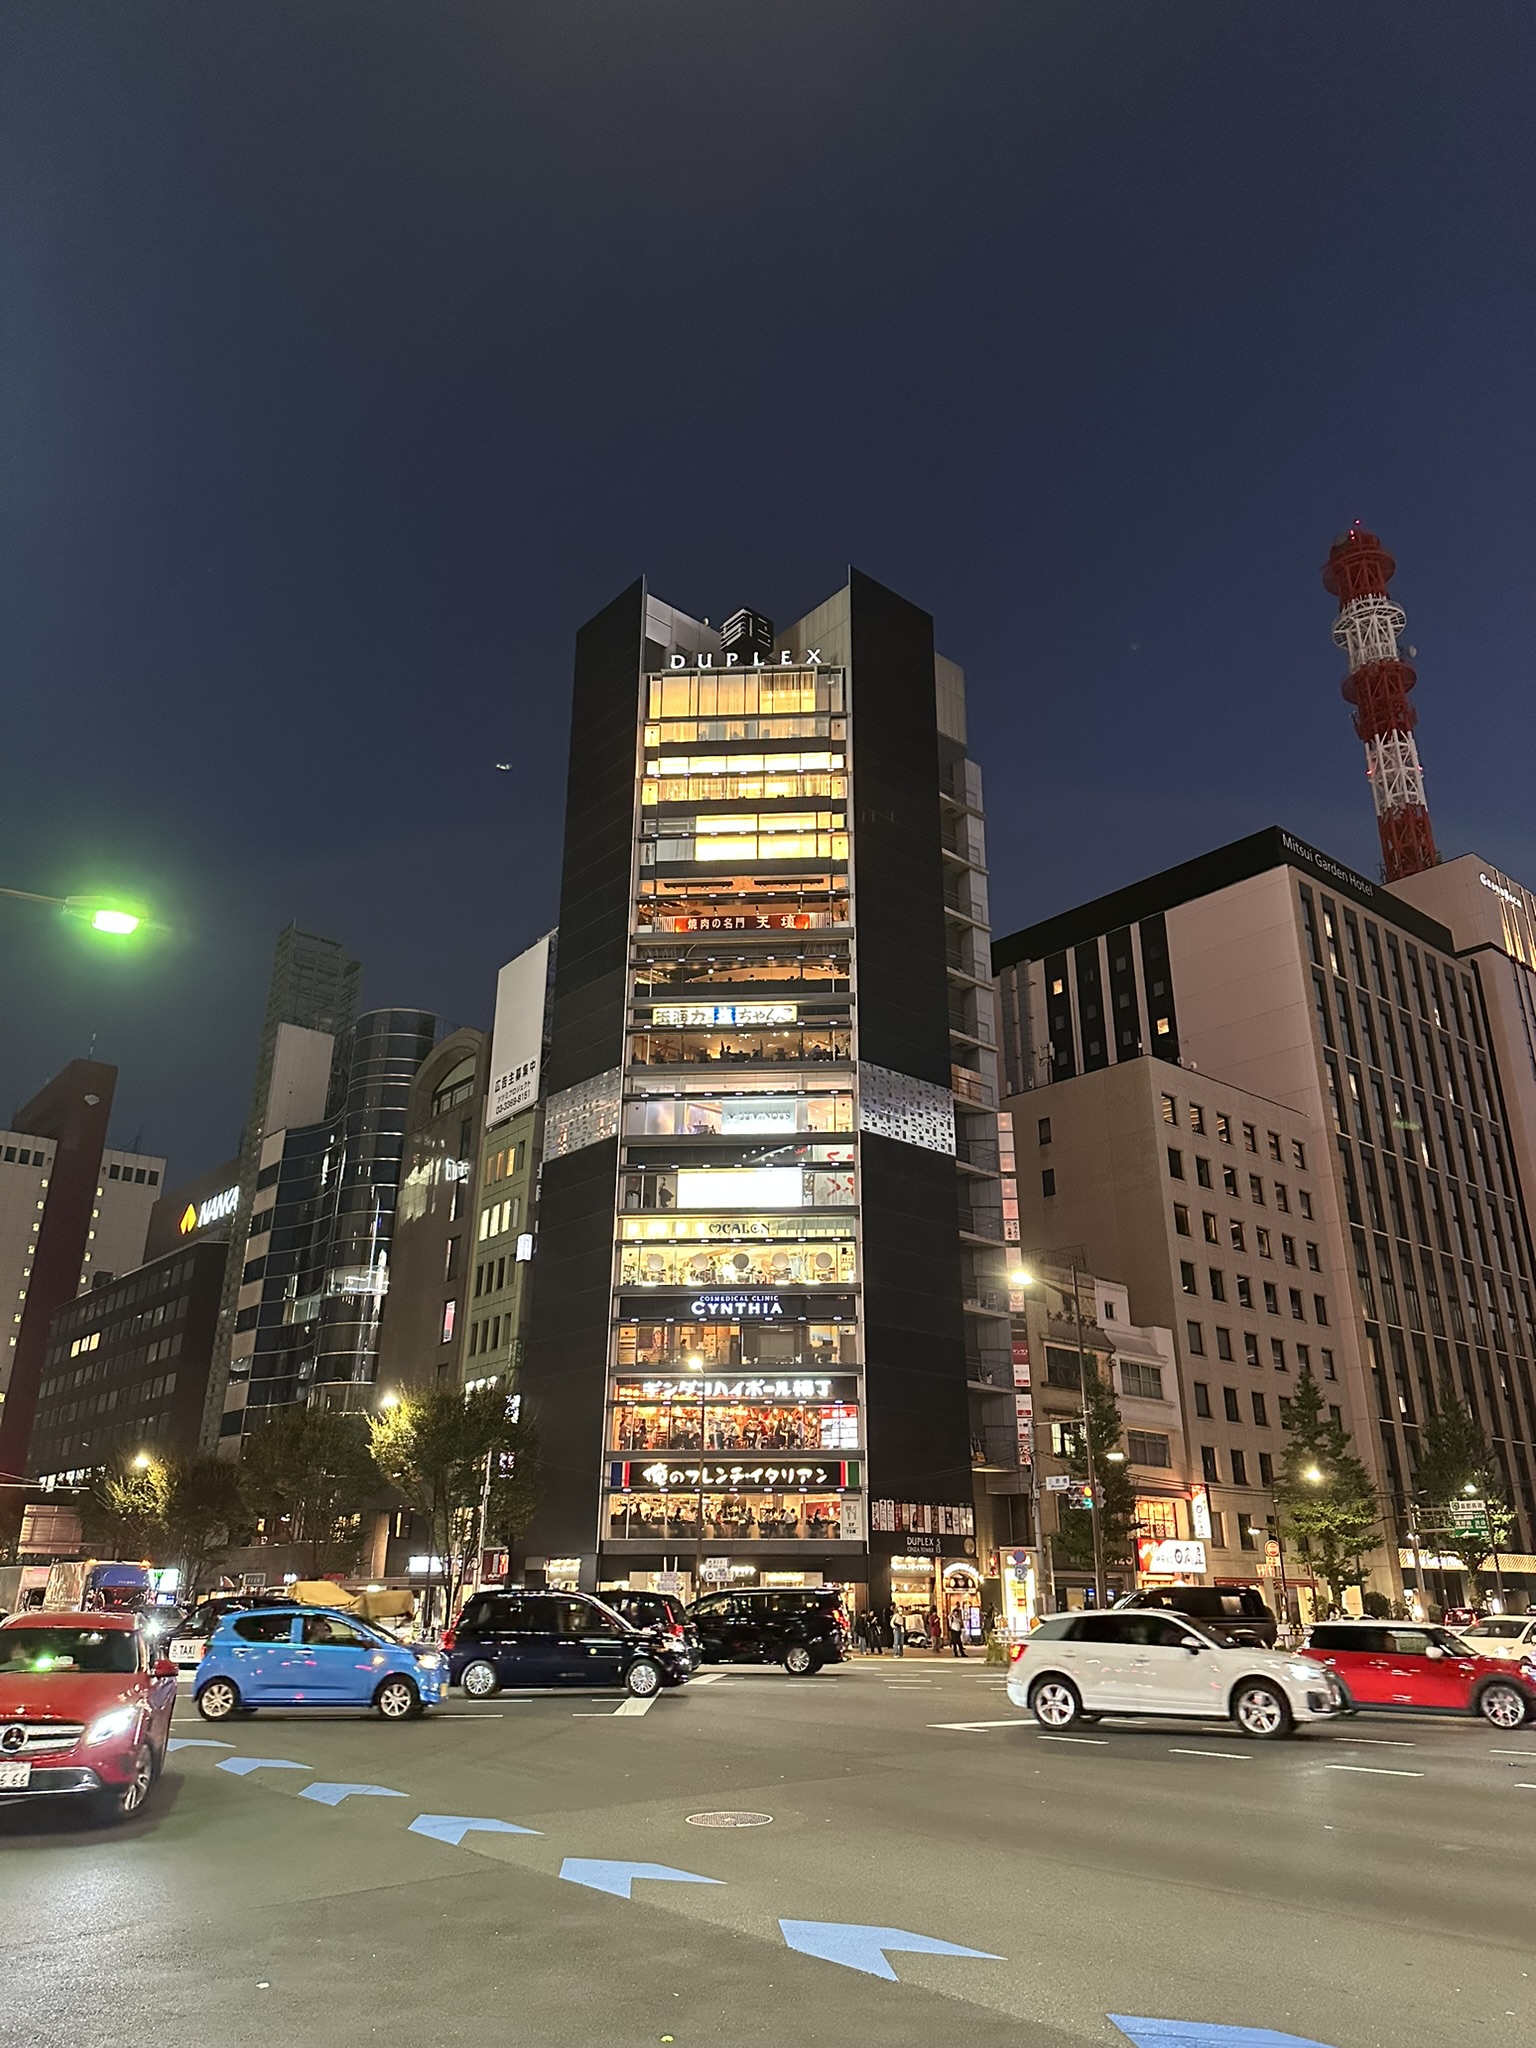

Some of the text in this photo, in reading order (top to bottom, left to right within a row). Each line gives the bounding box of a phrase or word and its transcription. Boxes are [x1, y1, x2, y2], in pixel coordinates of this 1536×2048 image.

[670, 648, 822, 669] DUPLEX
[1282, 833, 1374, 897] Mitsui Garden Hotel
[494, 1059, 537, 1093] 広告主募集中
[690, 1301, 783, 1315] CYNTHIA
[906, 1536, 934, 1547] DUPLEX
[179, 1644, 196, 1655] TAXI
